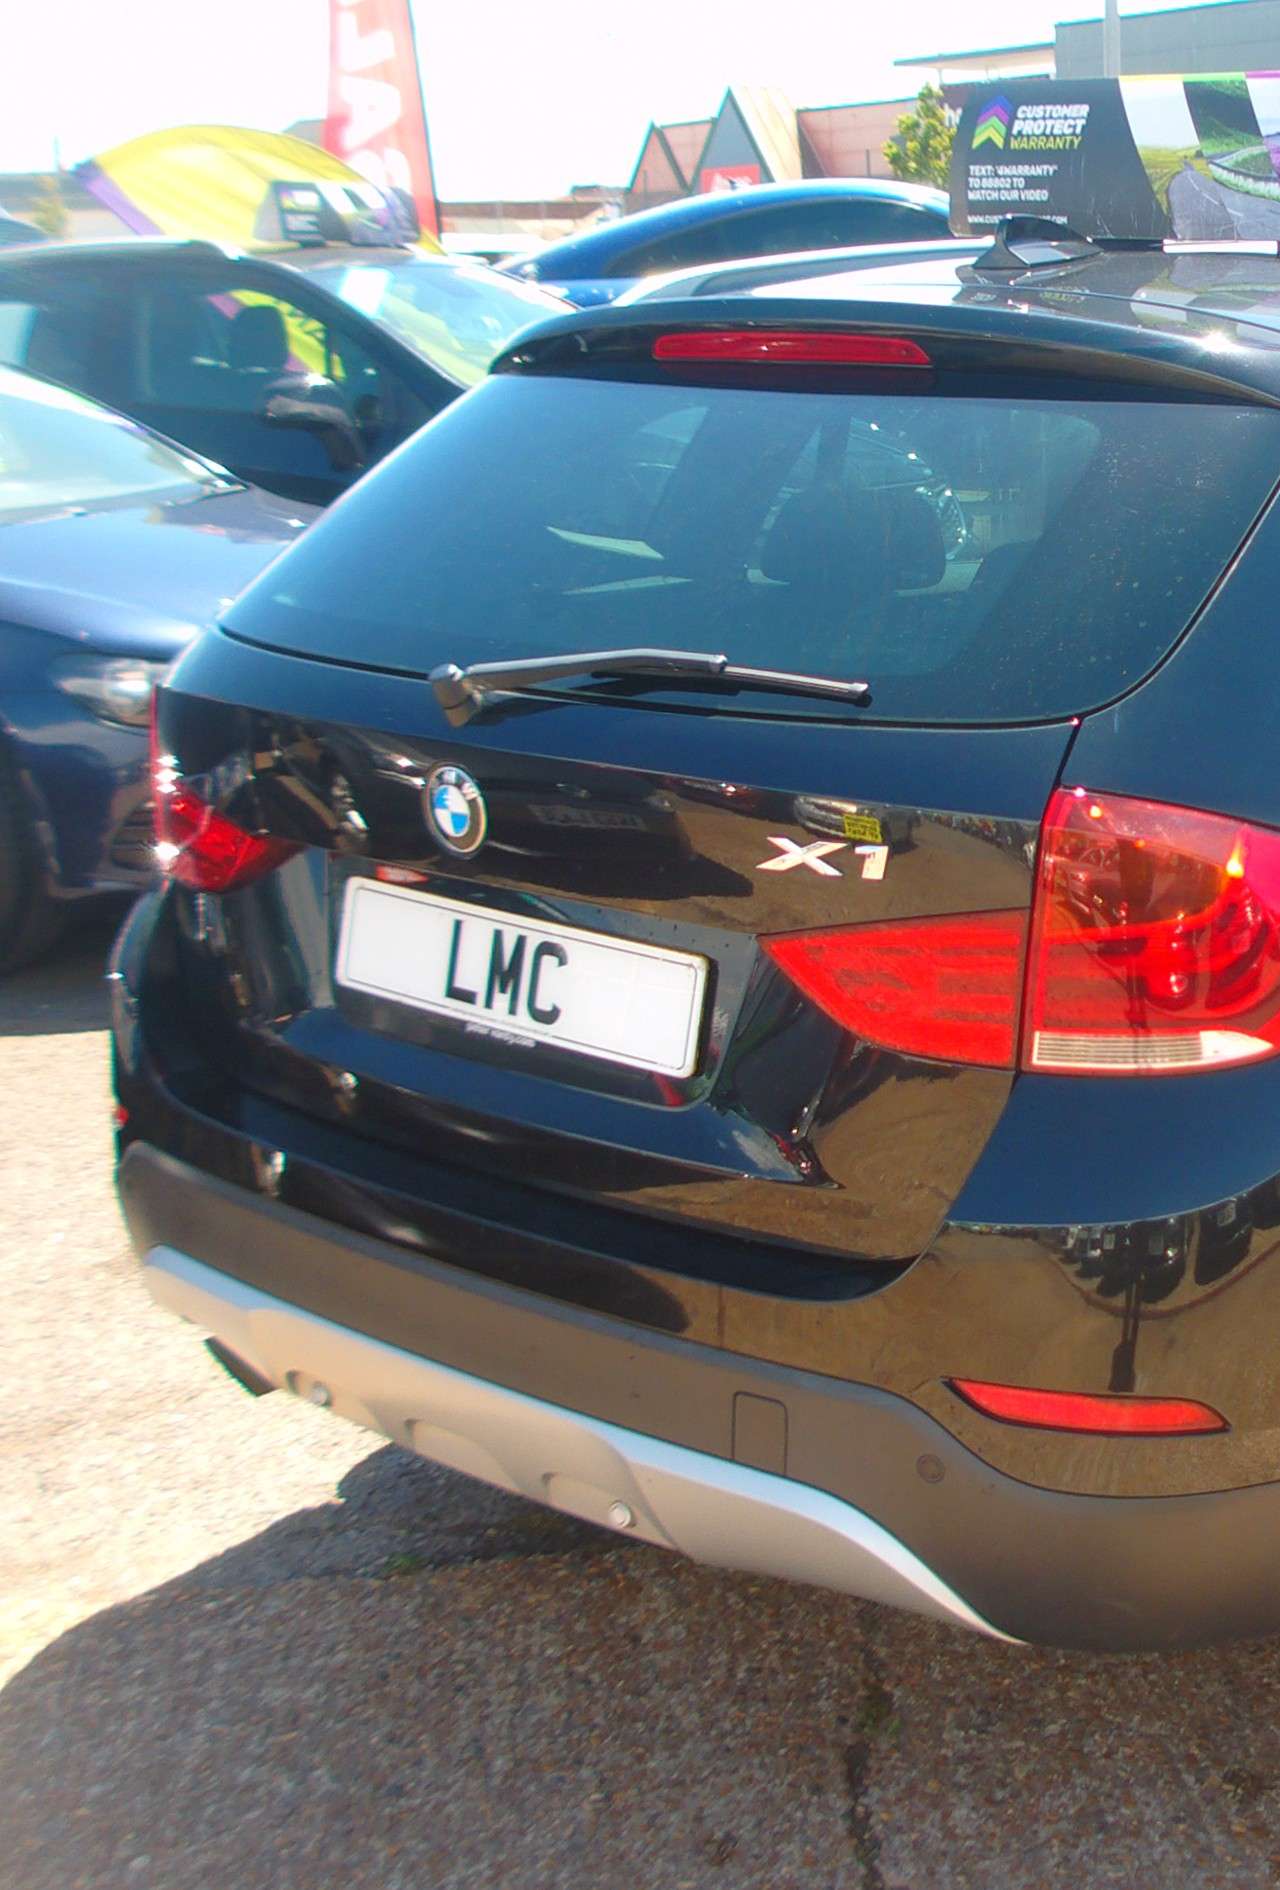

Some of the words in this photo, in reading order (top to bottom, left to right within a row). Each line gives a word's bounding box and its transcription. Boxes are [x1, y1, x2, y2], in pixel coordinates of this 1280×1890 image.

[1017, 104, 1089, 118] CUSTOMER
[1012, 119, 1086, 135] PROTECT
[1010, 136, 1082, 150] WARRANTY
[968, 177, 981, 188] TO
[1012, 177, 1025, 188] TO
[967, 189, 998, 201] WATCH
[1000, 189, 1019, 201] OUR
[1020, 189, 1048, 201] VIDEO
[755, 836, 889, 880] X1
[445, 918, 568, 1025] LMC
